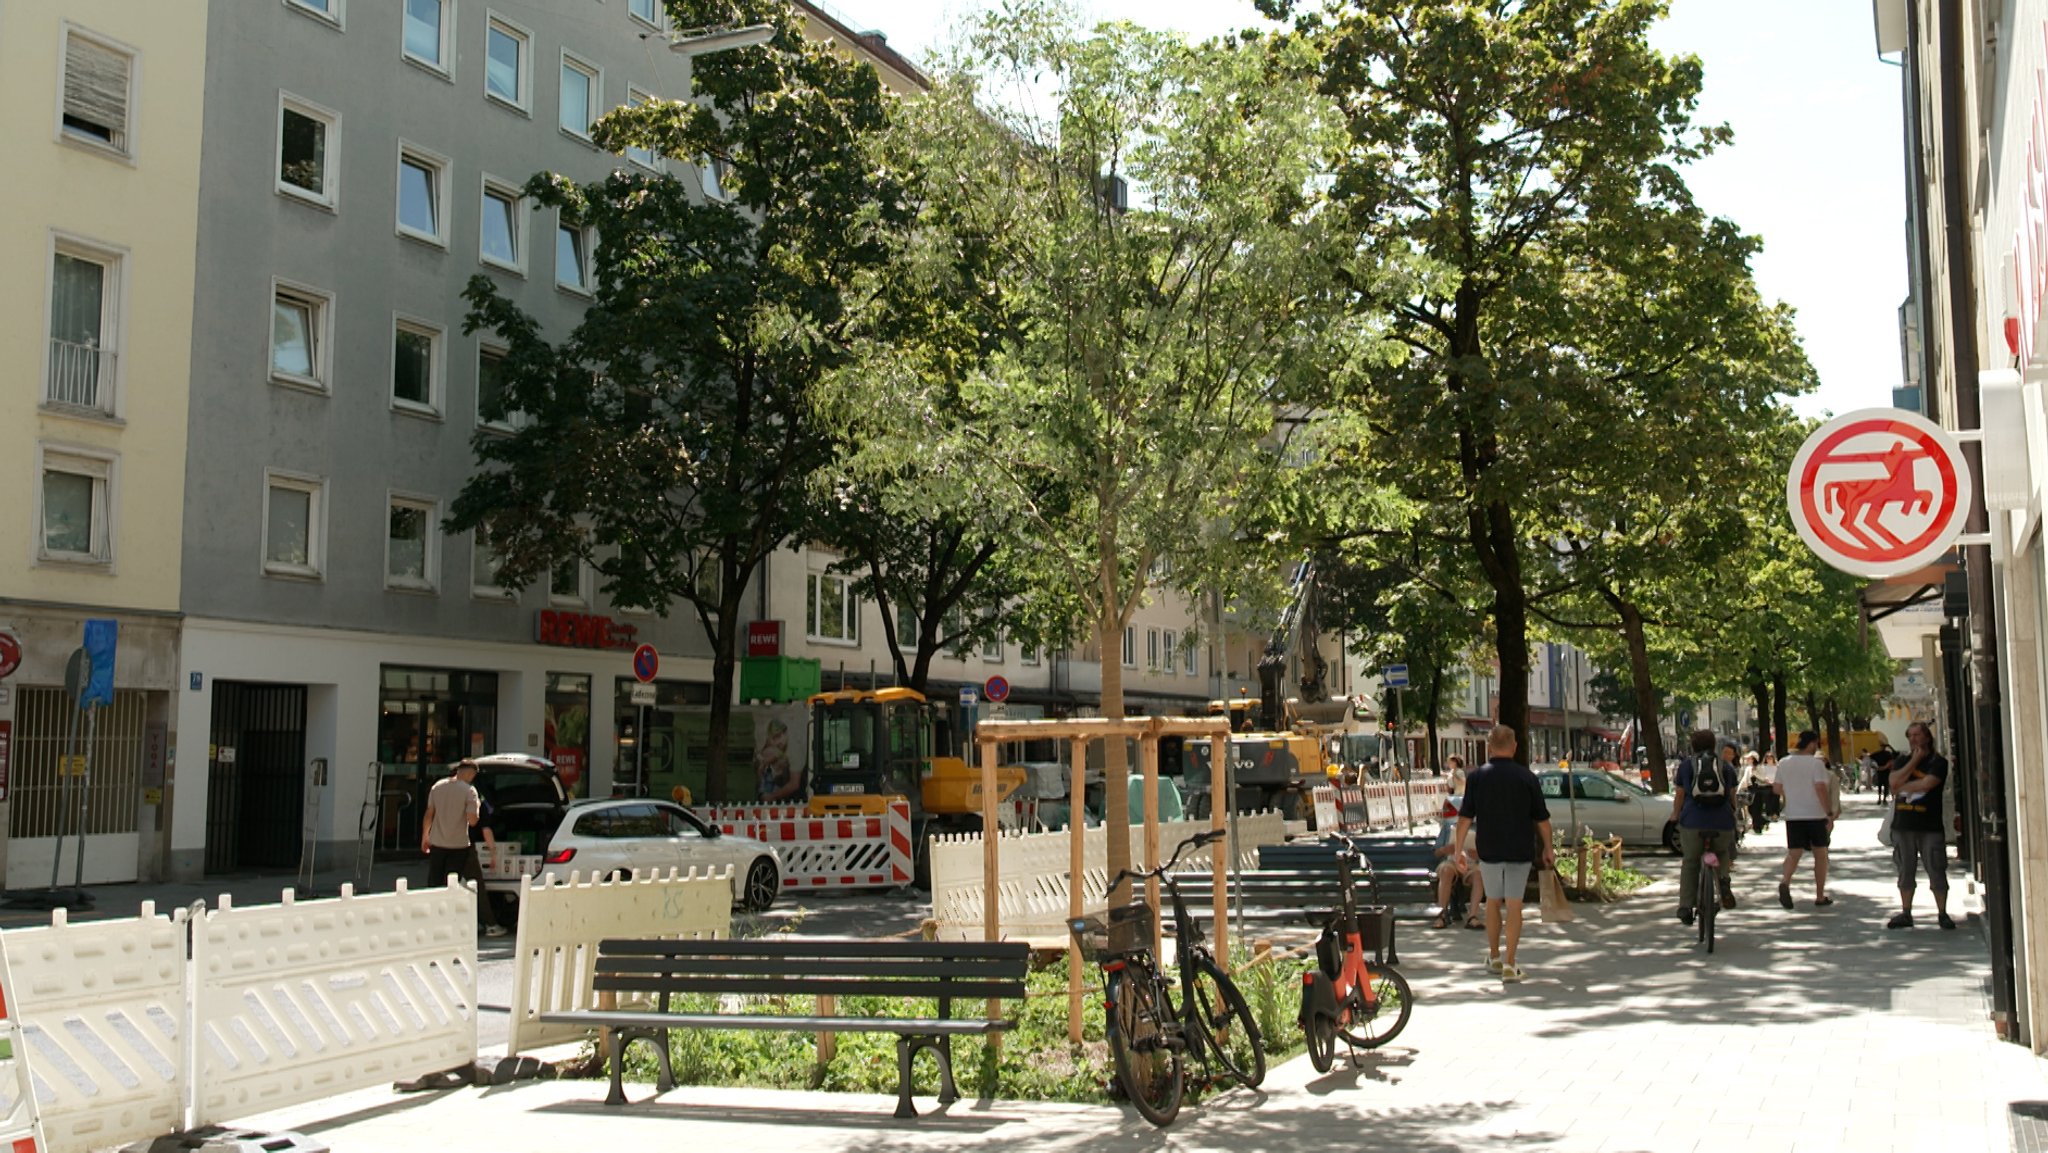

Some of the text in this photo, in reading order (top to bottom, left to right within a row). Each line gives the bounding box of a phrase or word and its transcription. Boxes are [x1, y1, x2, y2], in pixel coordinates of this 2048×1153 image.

[540, 608, 615, 649] REWE
[750, 633, 778, 645] REWE
[556, 755, 577, 765] REWE
